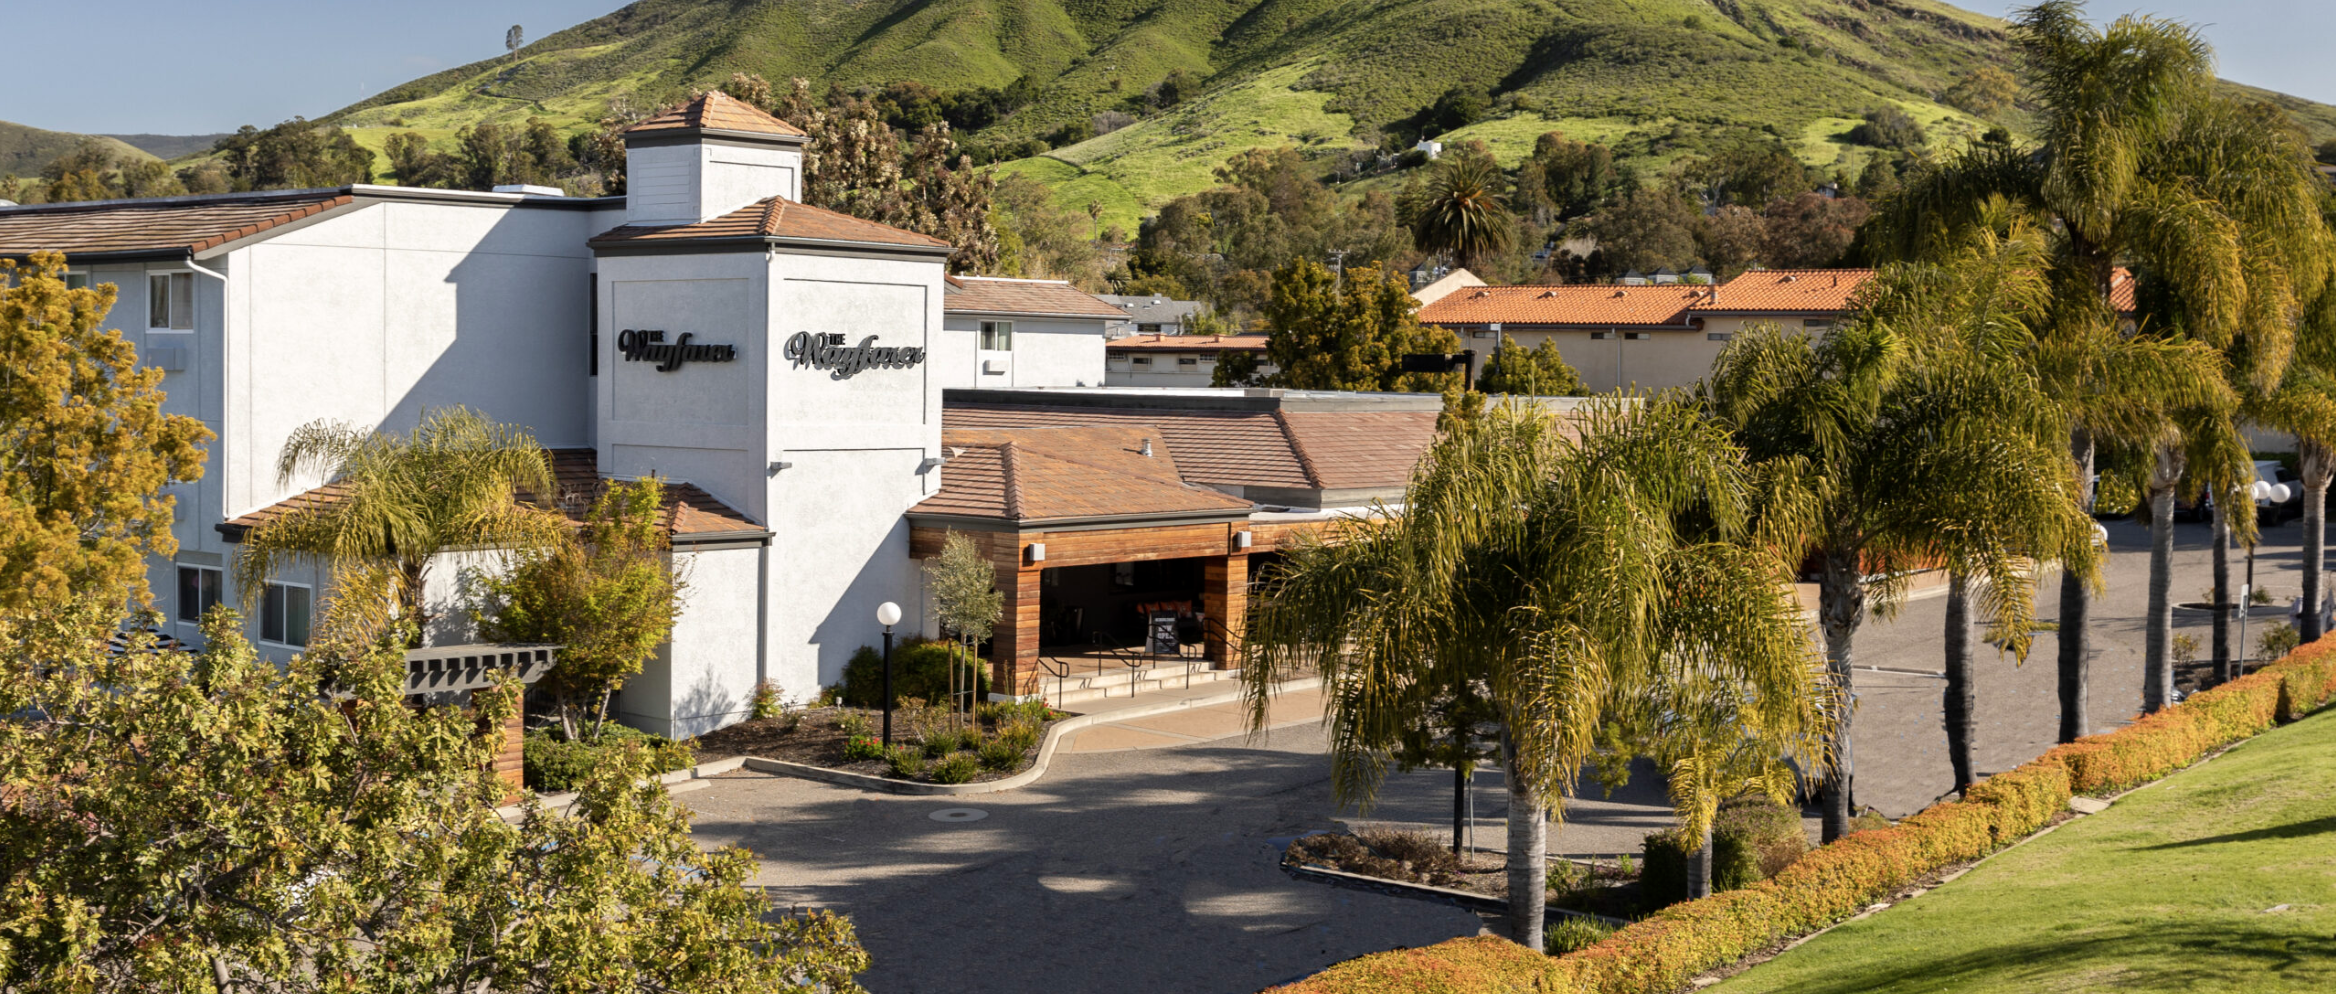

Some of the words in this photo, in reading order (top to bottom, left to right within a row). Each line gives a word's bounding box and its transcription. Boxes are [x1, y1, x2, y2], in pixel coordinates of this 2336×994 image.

[618, 329, 736, 372] Wayfarer
[789, 331, 926, 376] Wayfarer
[828, 333, 846, 345] THE
